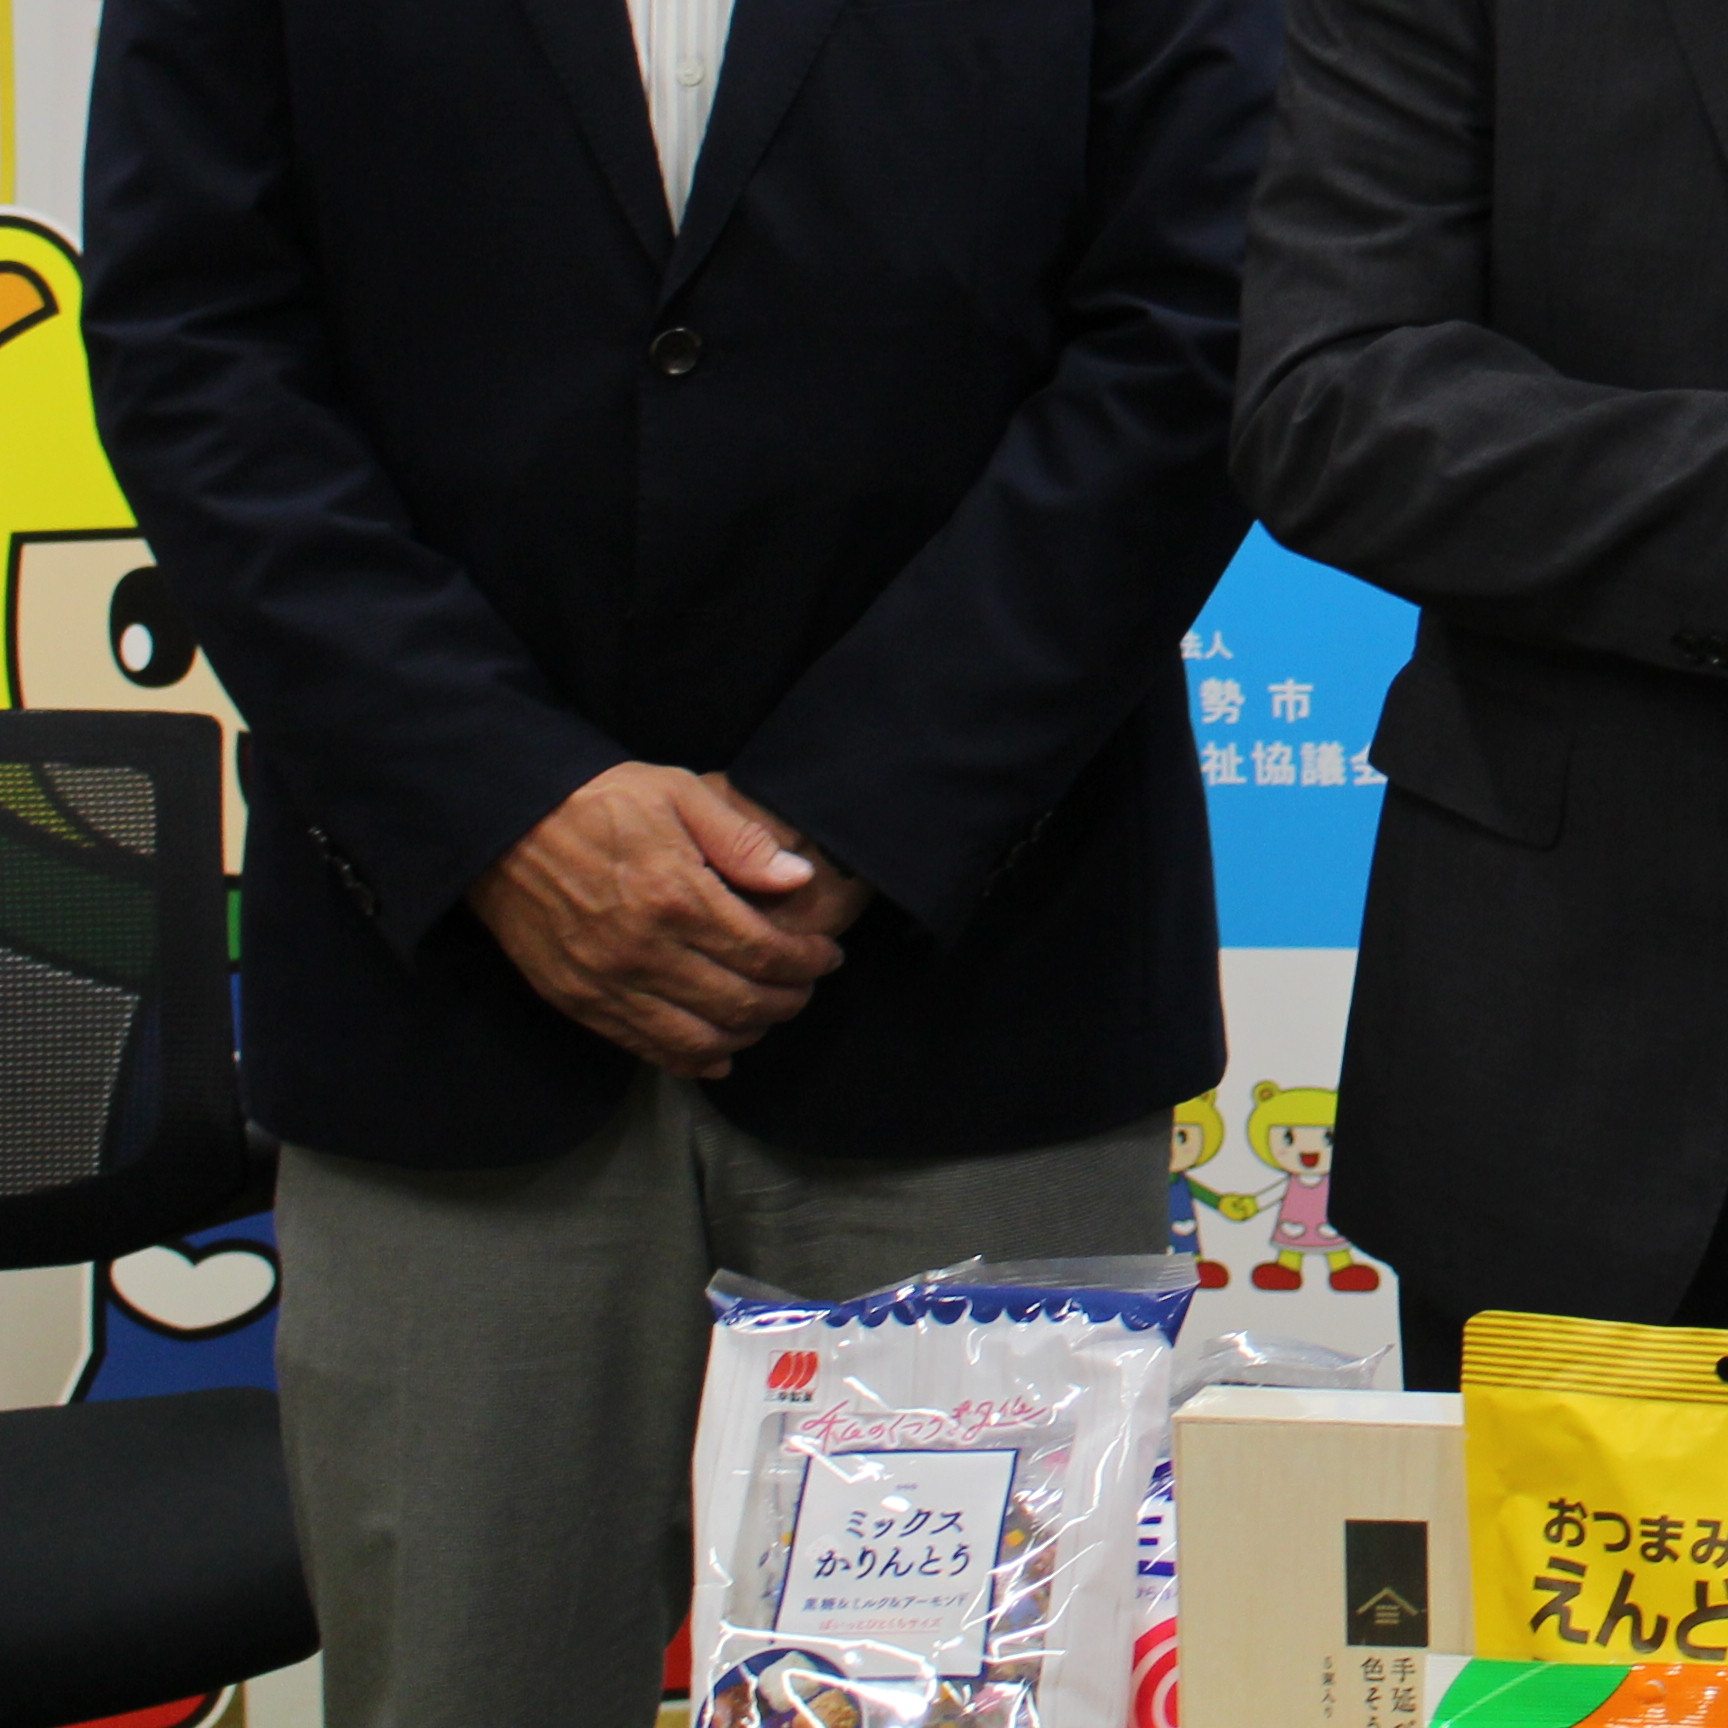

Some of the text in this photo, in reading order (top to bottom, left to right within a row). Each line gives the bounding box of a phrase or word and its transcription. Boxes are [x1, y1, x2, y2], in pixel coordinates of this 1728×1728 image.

[846, 1508, 964, 1540] ミックス
[814, 1544, 971, 1580] かりんとう
